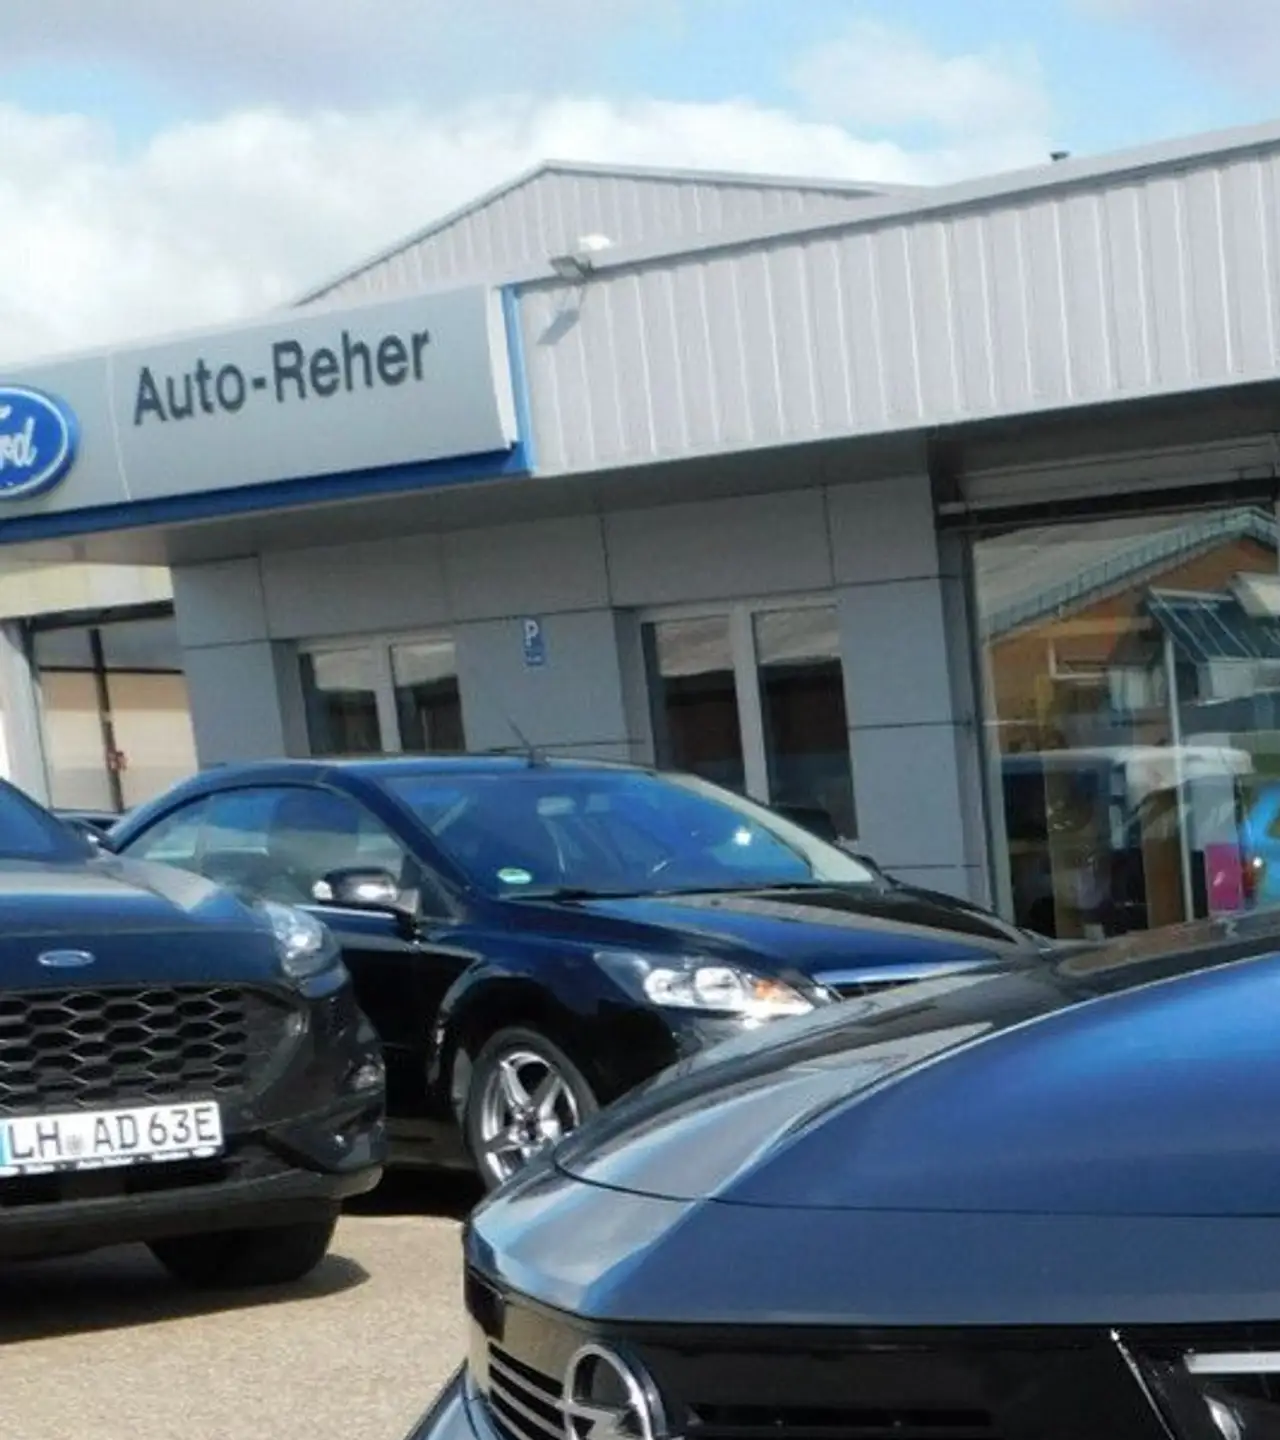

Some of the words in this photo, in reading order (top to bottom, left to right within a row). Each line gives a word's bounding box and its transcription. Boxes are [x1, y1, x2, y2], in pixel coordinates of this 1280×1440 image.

[133, 330, 429, 425] Auto-Reher
[8, 1121, 62, 1159] LH
[93, 1113, 139, 1152] AD
[150, 1106, 217, 1146] 63E
